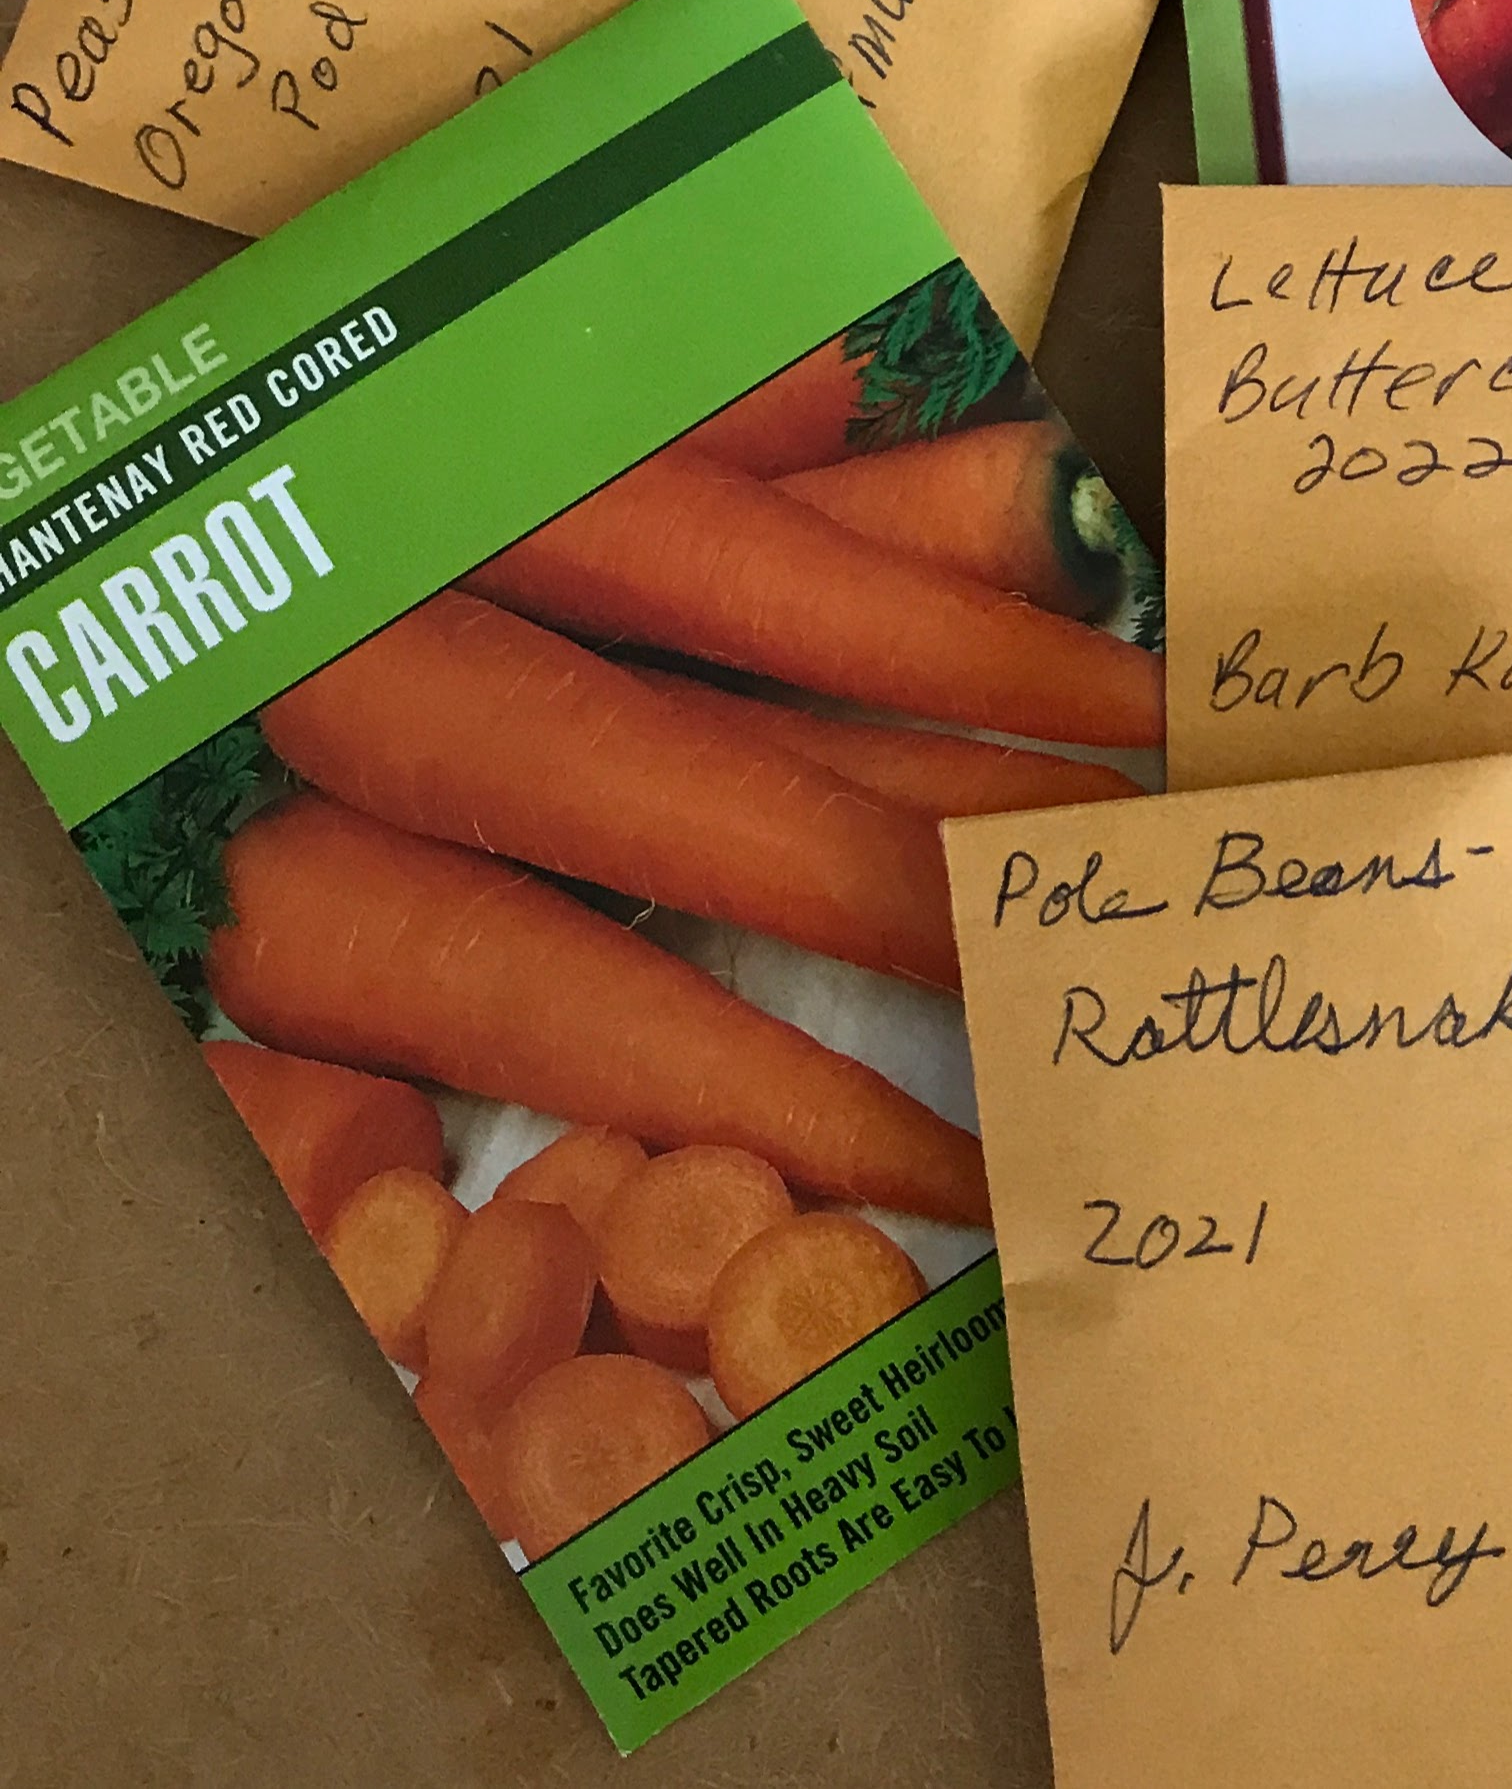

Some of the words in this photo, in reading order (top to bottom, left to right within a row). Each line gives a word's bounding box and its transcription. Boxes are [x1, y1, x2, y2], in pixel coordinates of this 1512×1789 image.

[271, 1, 368, 130] Pod
[179, 393, 262, 465] RED
[266, 306, 399, 408] CORED
[5, 463, 335, 744] CARROT
[1209, 621, 1404, 713] Barb
[994, 850, 1168, 927] Pole
[1082, 1198, 1268, 1269] 2021
[567, 1506, 698, 1615] Favorite
[695, 1457, 792, 1526] Crisp,
[786, 1383, 885, 1464] Sweet
[593, 1589, 677, 1659] Does
[671, 1536, 748, 1603] Well
[744, 1516, 786, 1555] In
[780, 1453, 877, 1532] Heavy
[874, 1404, 940, 1464] Soil
[618, 1597, 750, 1701] Tapered
[745, 1539, 840, 1616] Roots
[837, 1500, 895, 1554] Are
[890, 1449, 969, 1515] Easy
[962, 1424, 1006, 1460] To
